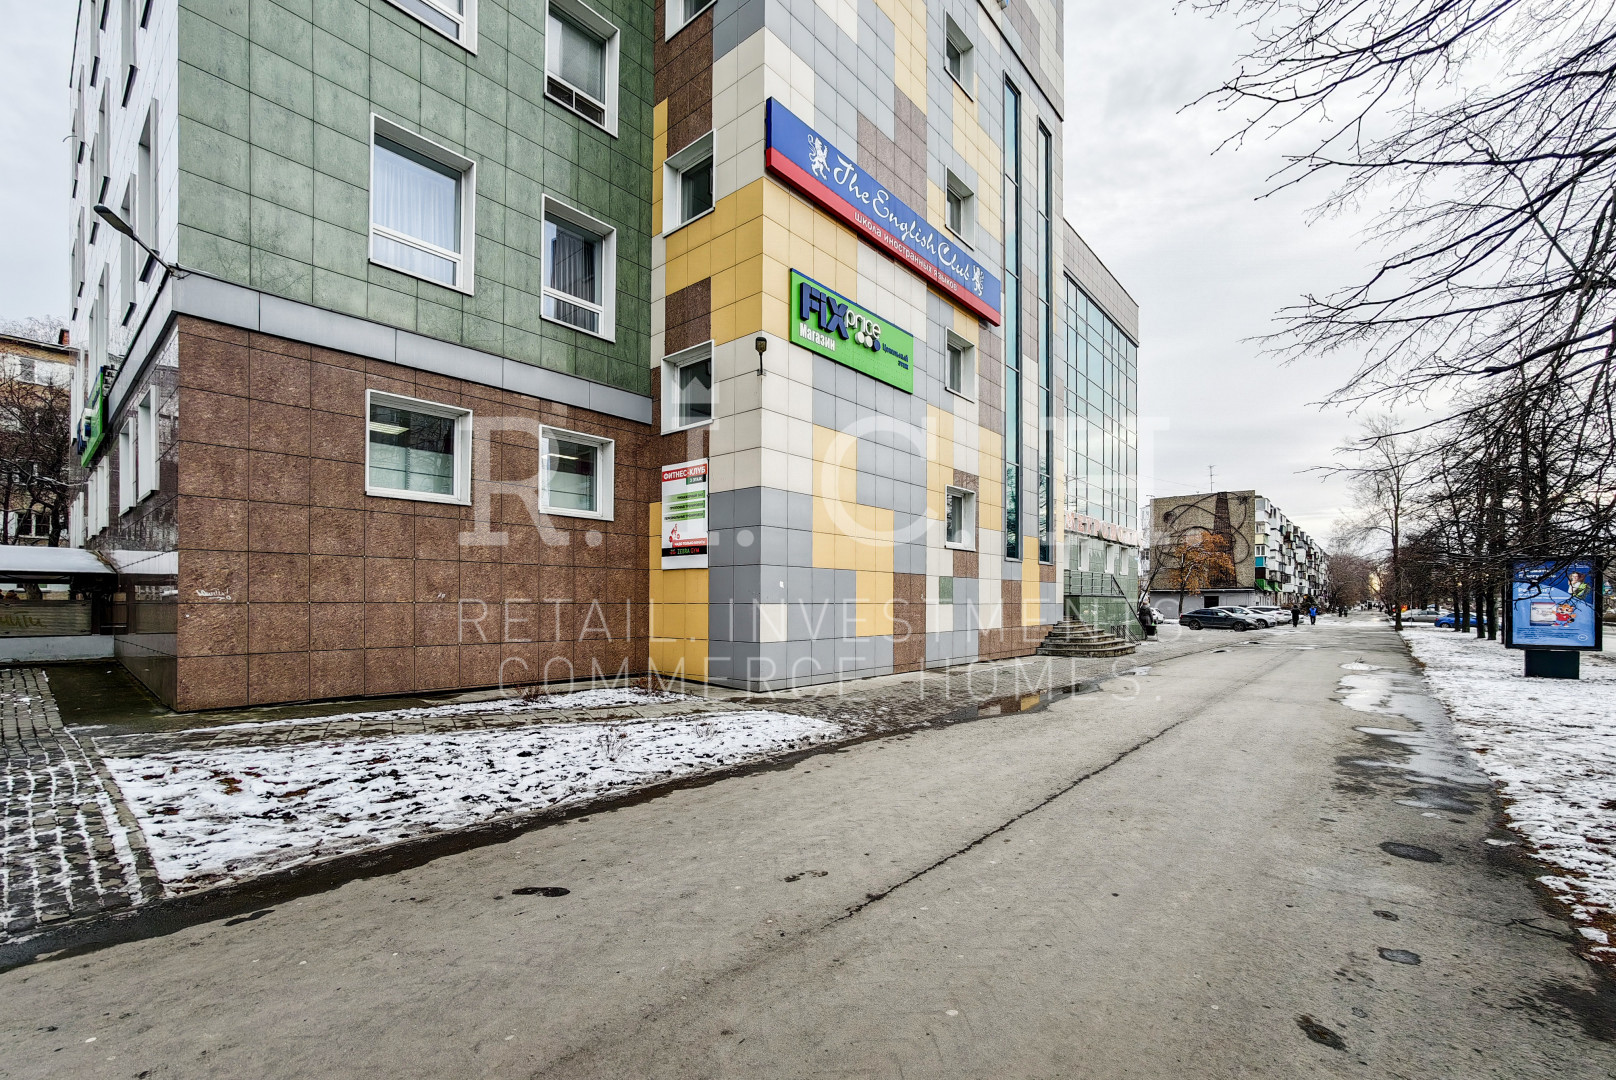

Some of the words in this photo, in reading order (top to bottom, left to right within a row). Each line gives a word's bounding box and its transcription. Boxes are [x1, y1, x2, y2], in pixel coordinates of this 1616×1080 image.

[833, 154, 871, 204] The
[872, 189, 937, 255] English
[937, 242, 972, 281] Club
[854, 211, 882, 238] школа
[883, 228, 933, 276] иностранных
[933, 266, 959, 292] языков
[799, 322, 836, 352] Магазин
[845, 309, 881, 340] price
[663, 466, 706, 480] ФИТНЕС-КЛУБ
